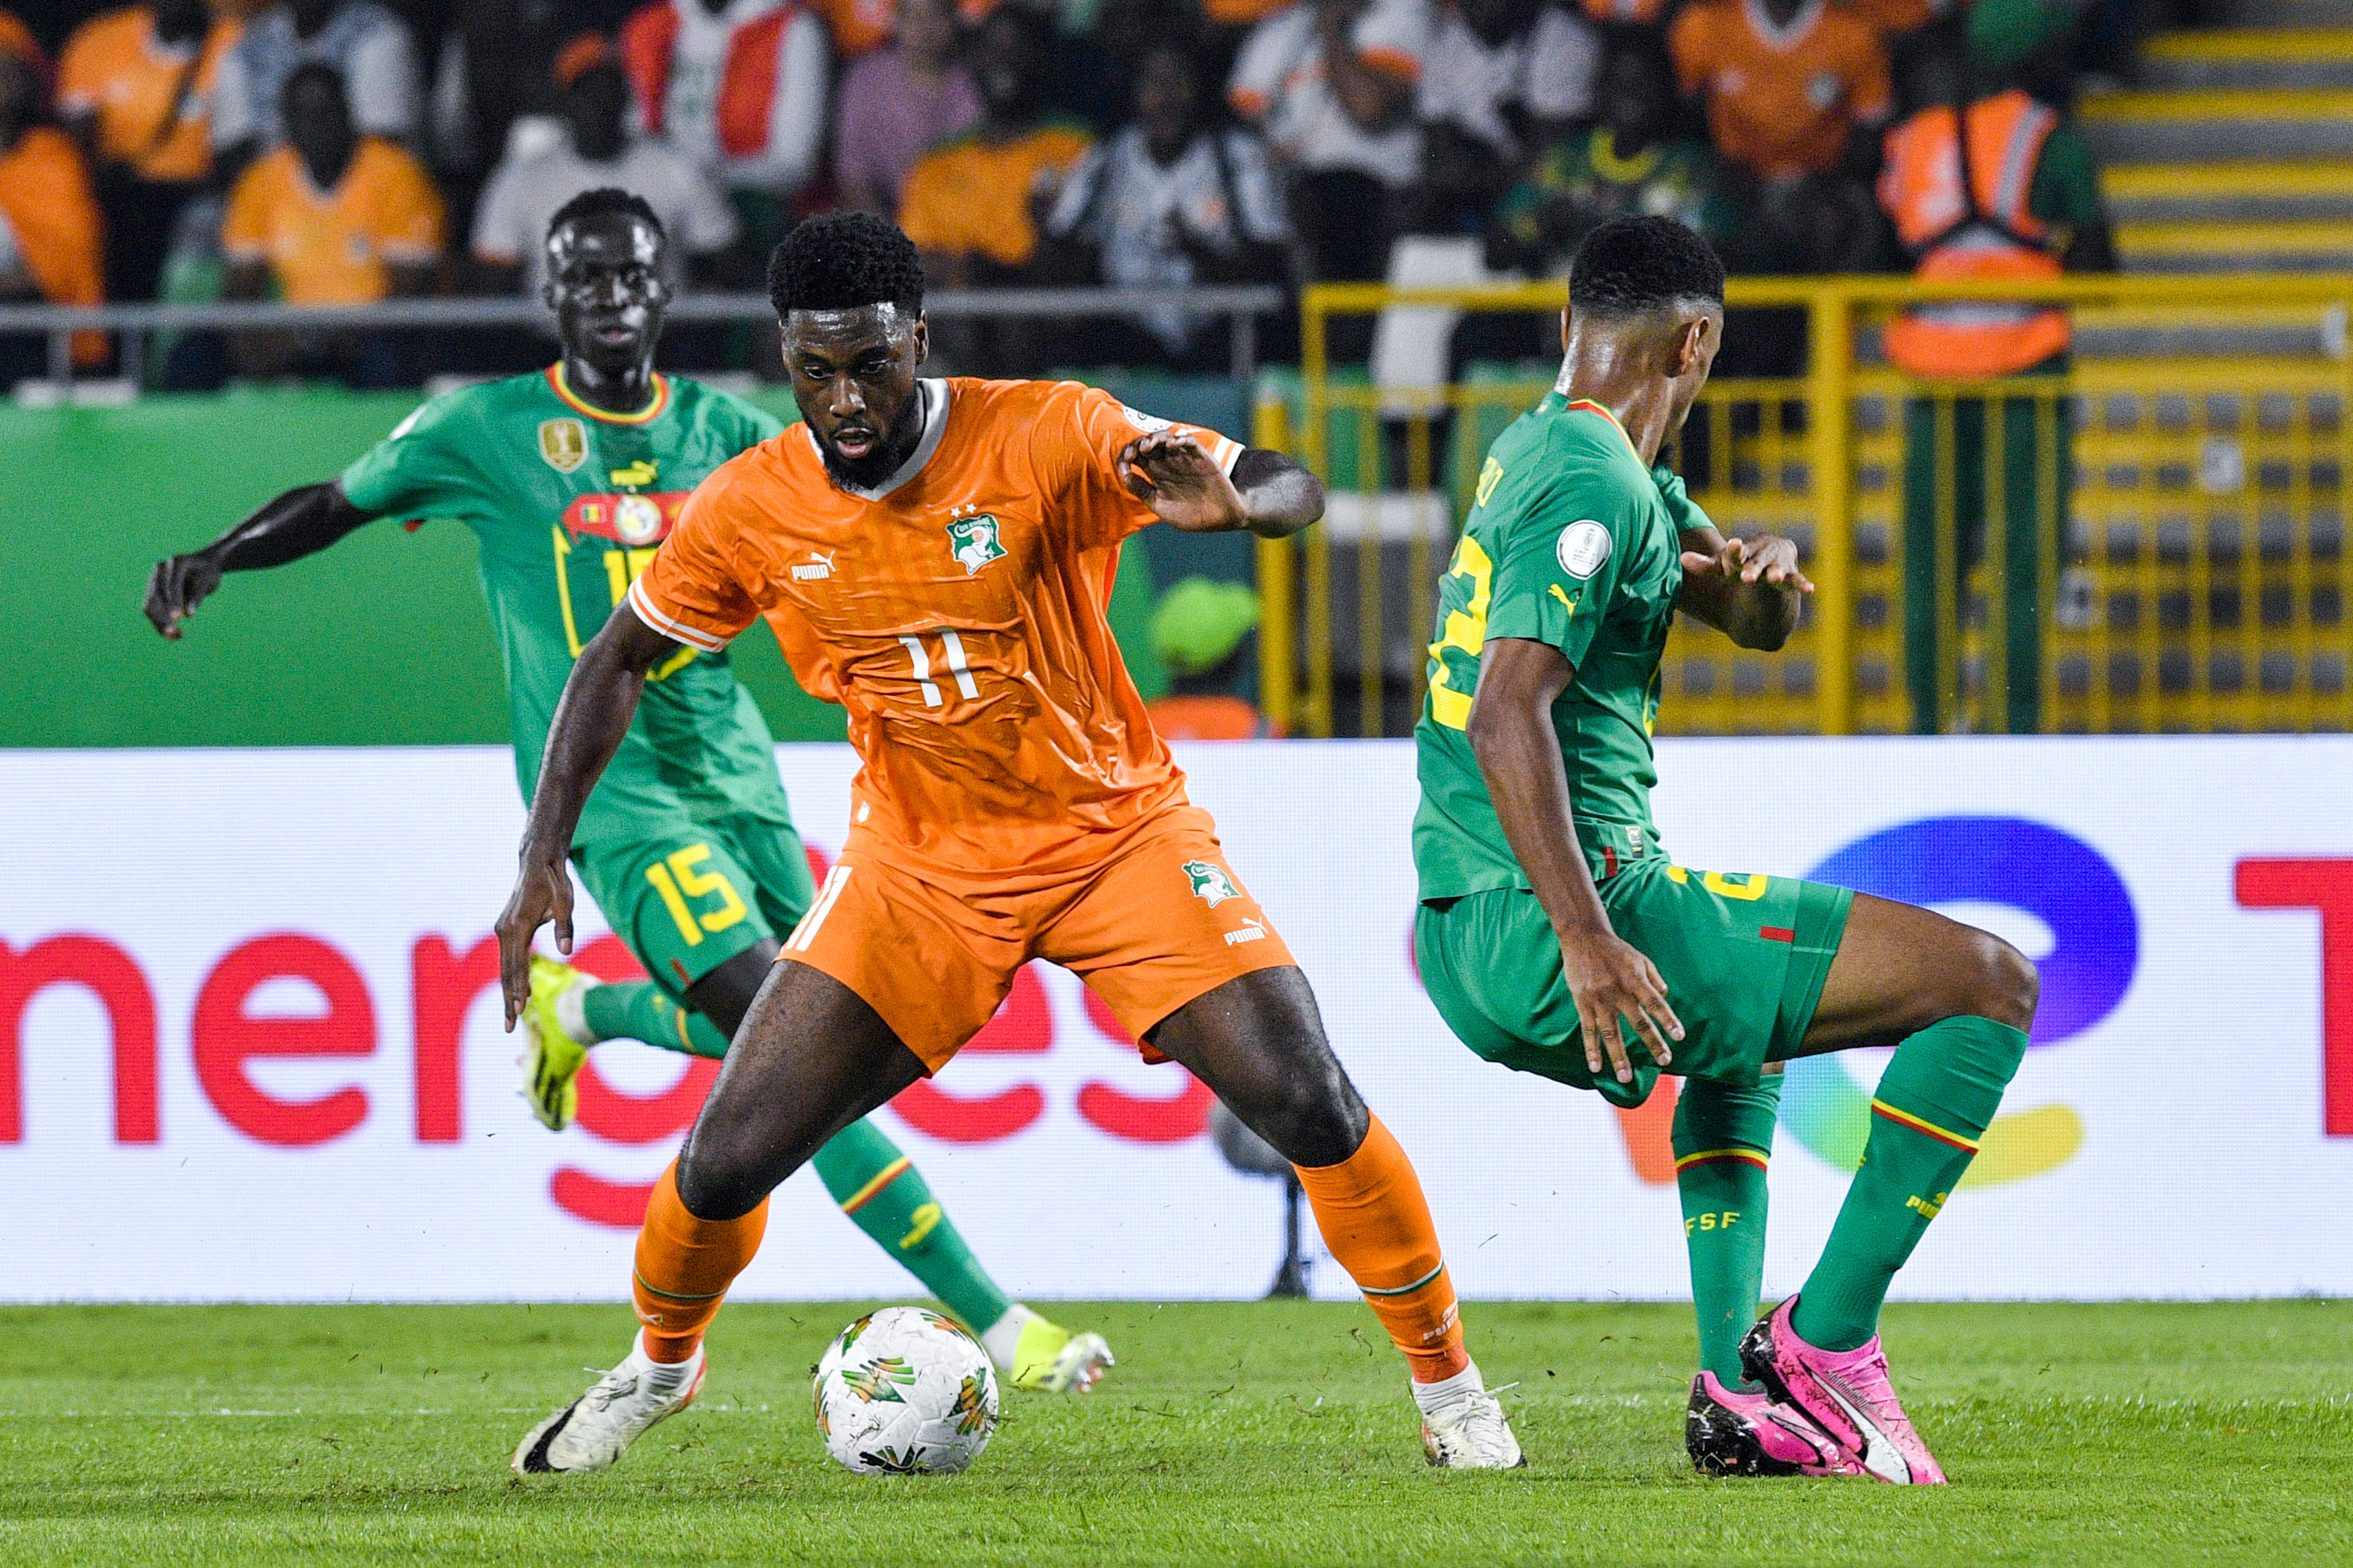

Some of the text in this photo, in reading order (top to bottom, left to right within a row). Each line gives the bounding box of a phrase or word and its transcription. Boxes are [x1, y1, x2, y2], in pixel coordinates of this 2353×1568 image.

[791, 564, 831, 581] PUMA
[897, 625, 979, 708] 11
[645, 843, 748, 947] 15
[1223, 926, 1266, 947] PUMA
[0, 845, 1218, 1230] nerges
[1685, 1211, 1741, 1238] FSF
